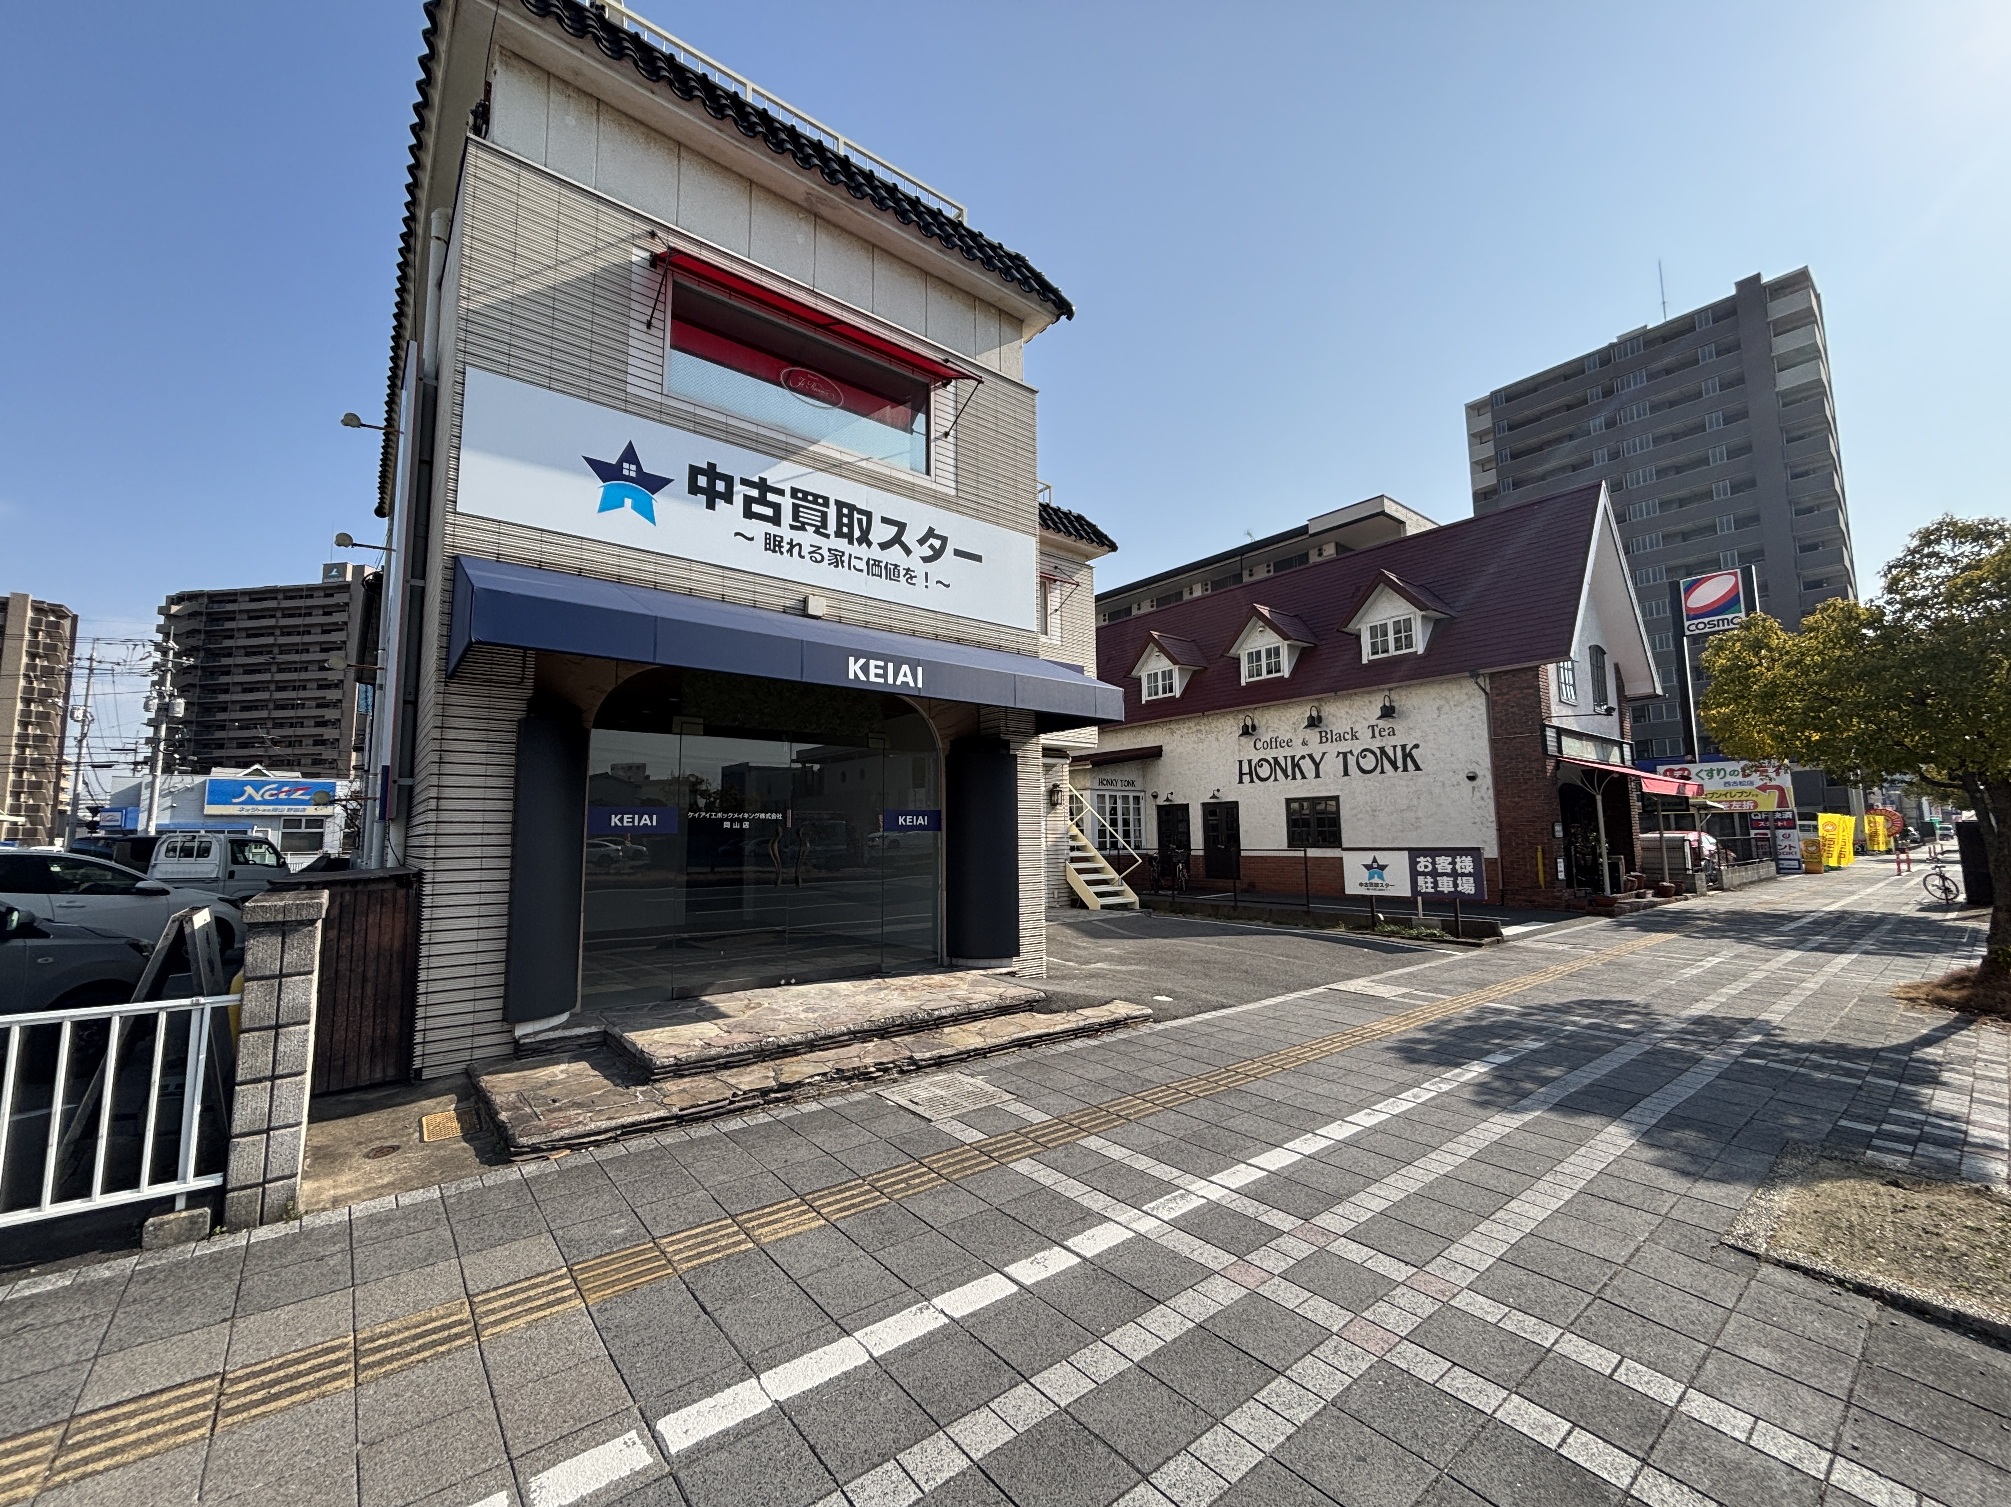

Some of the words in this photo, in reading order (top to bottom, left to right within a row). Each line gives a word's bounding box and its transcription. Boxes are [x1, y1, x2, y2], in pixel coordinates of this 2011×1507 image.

[687, 461, 983, 564] 中古買取スター
[849, 657, 923, 688] KEIAI
[1253, 736, 1293, 751] Coffee
[1301, 738, 1309, 746] &
[1318, 727, 1360, 744] Black
[1368, 724, 1396, 739] Tea
[1237, 752, 1328, 784] HONKY
[1335, 743, 1423, 777] TONK
[1098, 778, 1118, 787] HONKY
[232, 784, 312, 802] Netz
[611, 814, 657, 826] KEIAI
[898, 815, 928, 825] KEIAI
[1416, 856, 1474, 873] お客様
[1417, 876, 1475, 894] 駐車場
